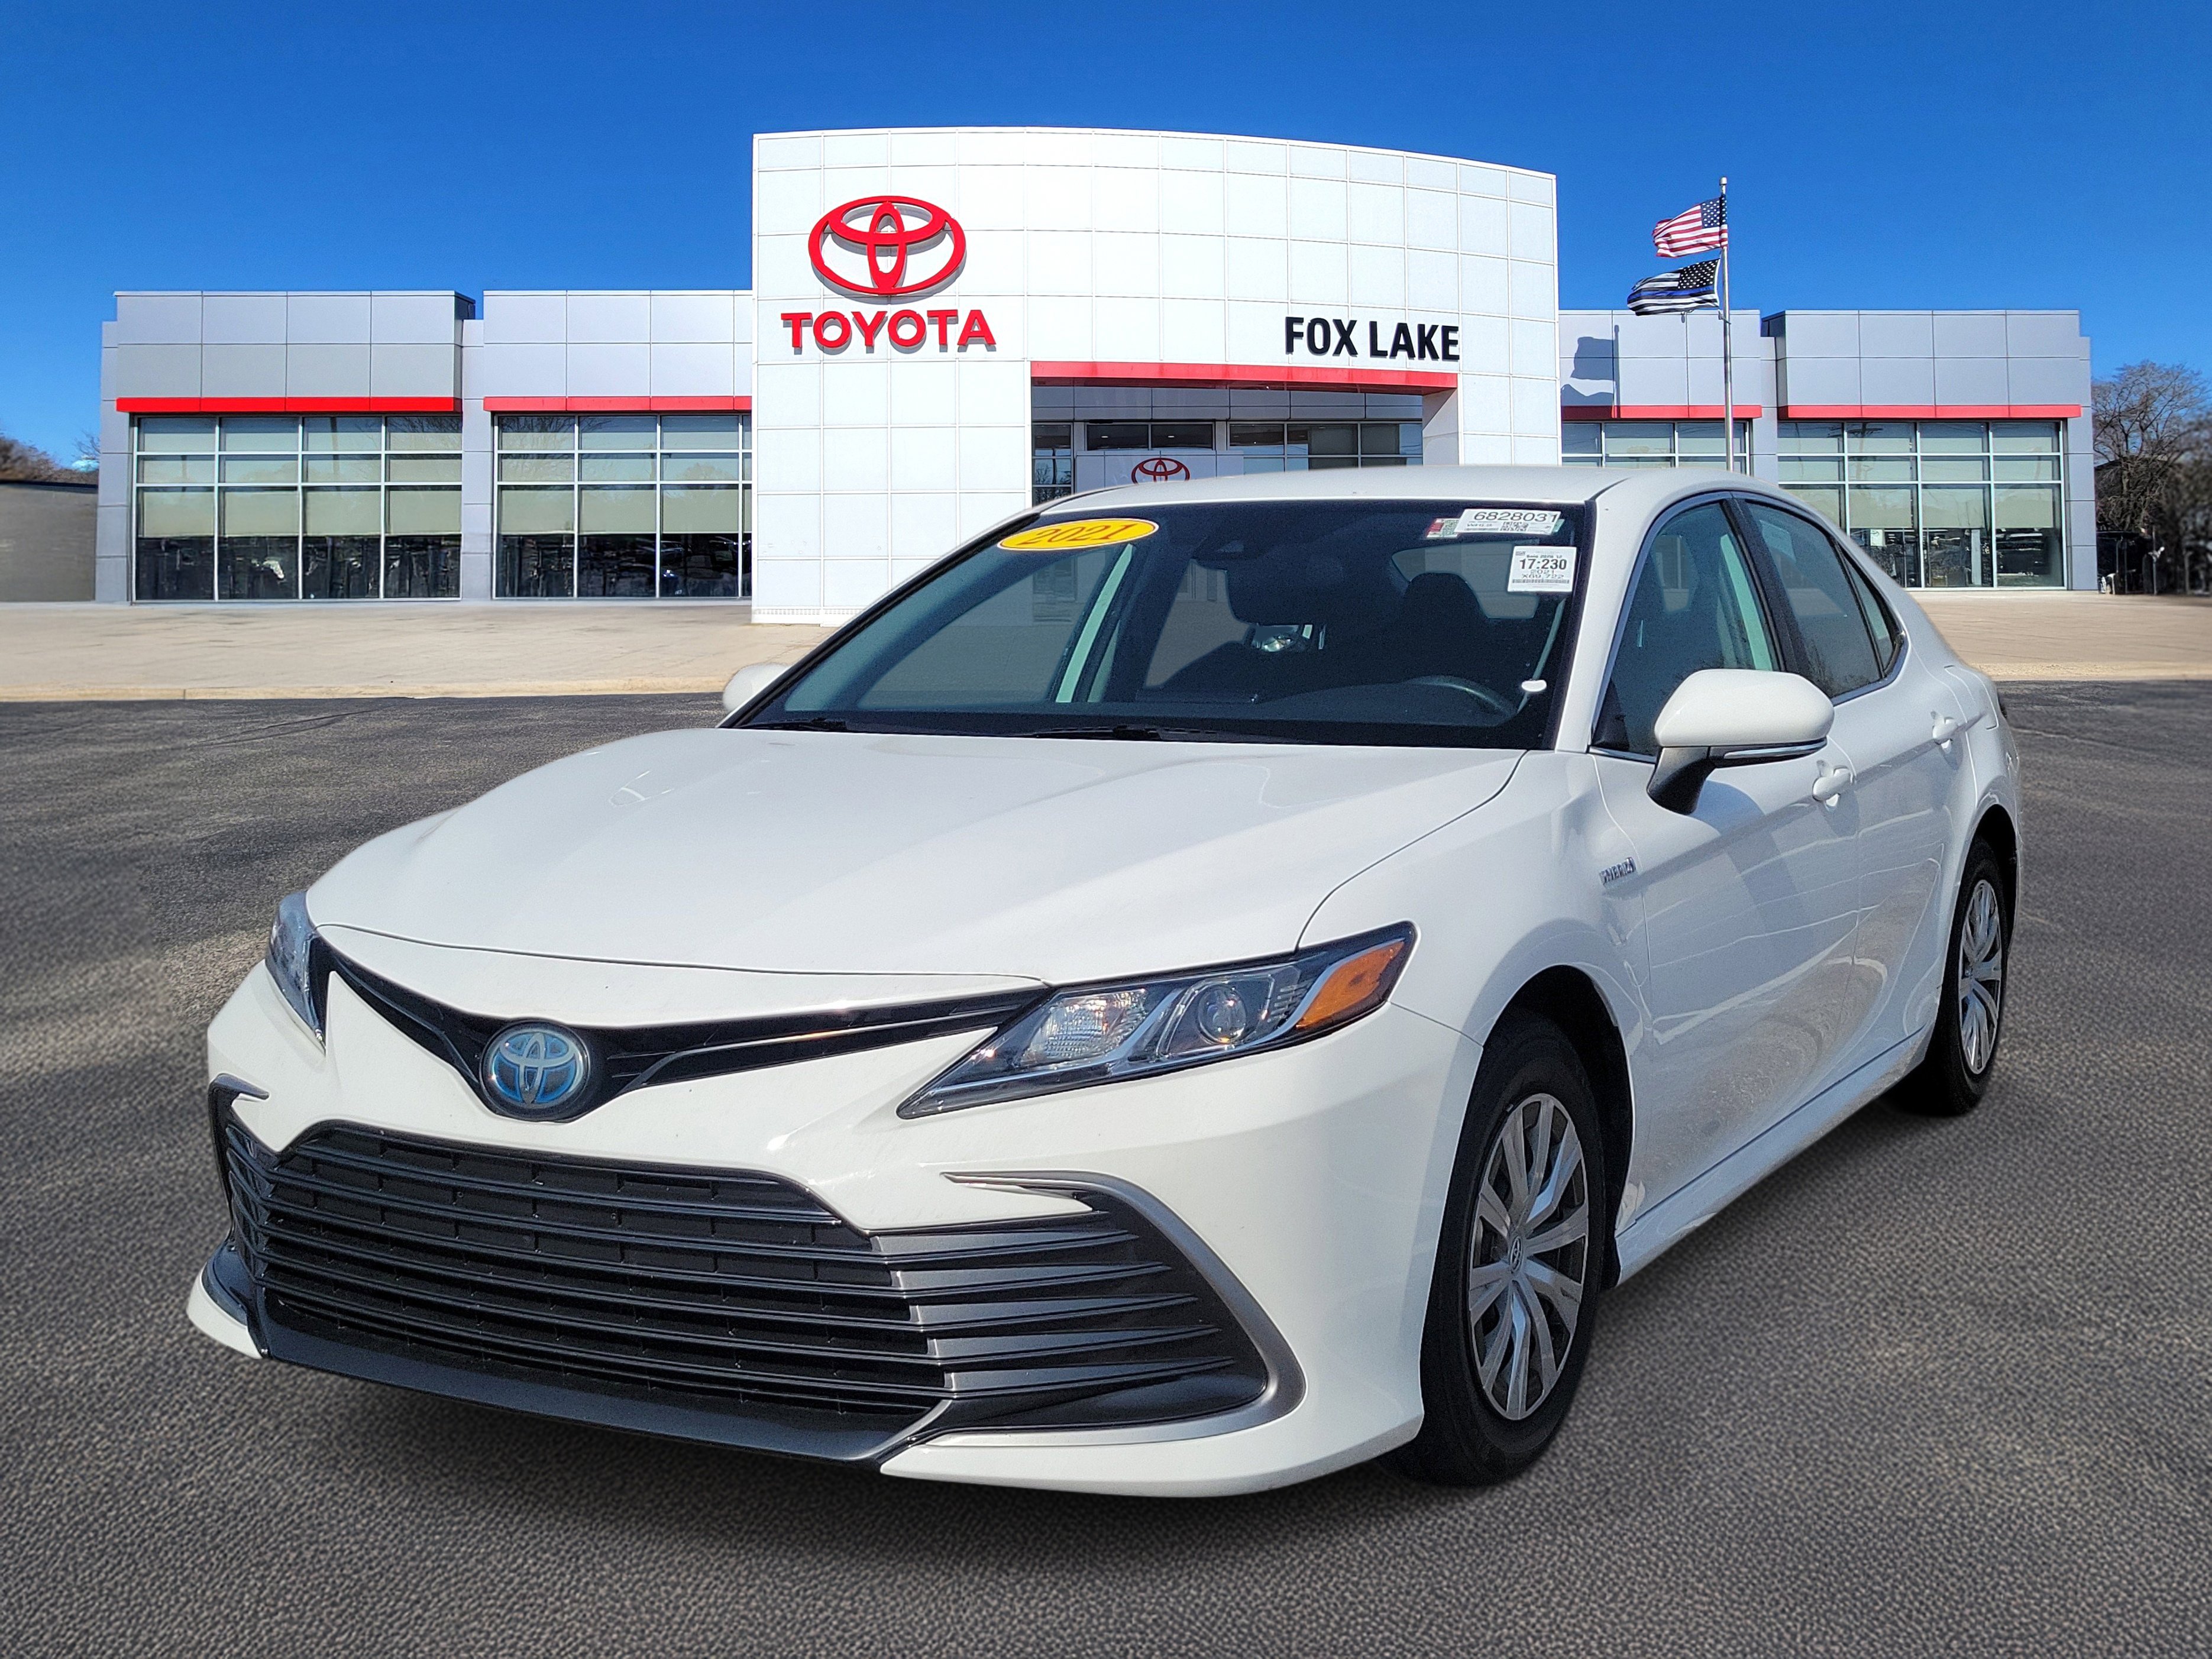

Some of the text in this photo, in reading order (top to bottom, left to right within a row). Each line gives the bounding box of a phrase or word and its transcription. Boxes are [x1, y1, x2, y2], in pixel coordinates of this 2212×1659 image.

[781, 309, 997, 350] TOYOTA
[1285, 316, 1460, 361] FOX LAKE
[1473, 511, 1558, 523] 6828031
[1016, 523, 1138, 545] 2021
[1519, 558, 1567, 570] 17:230
